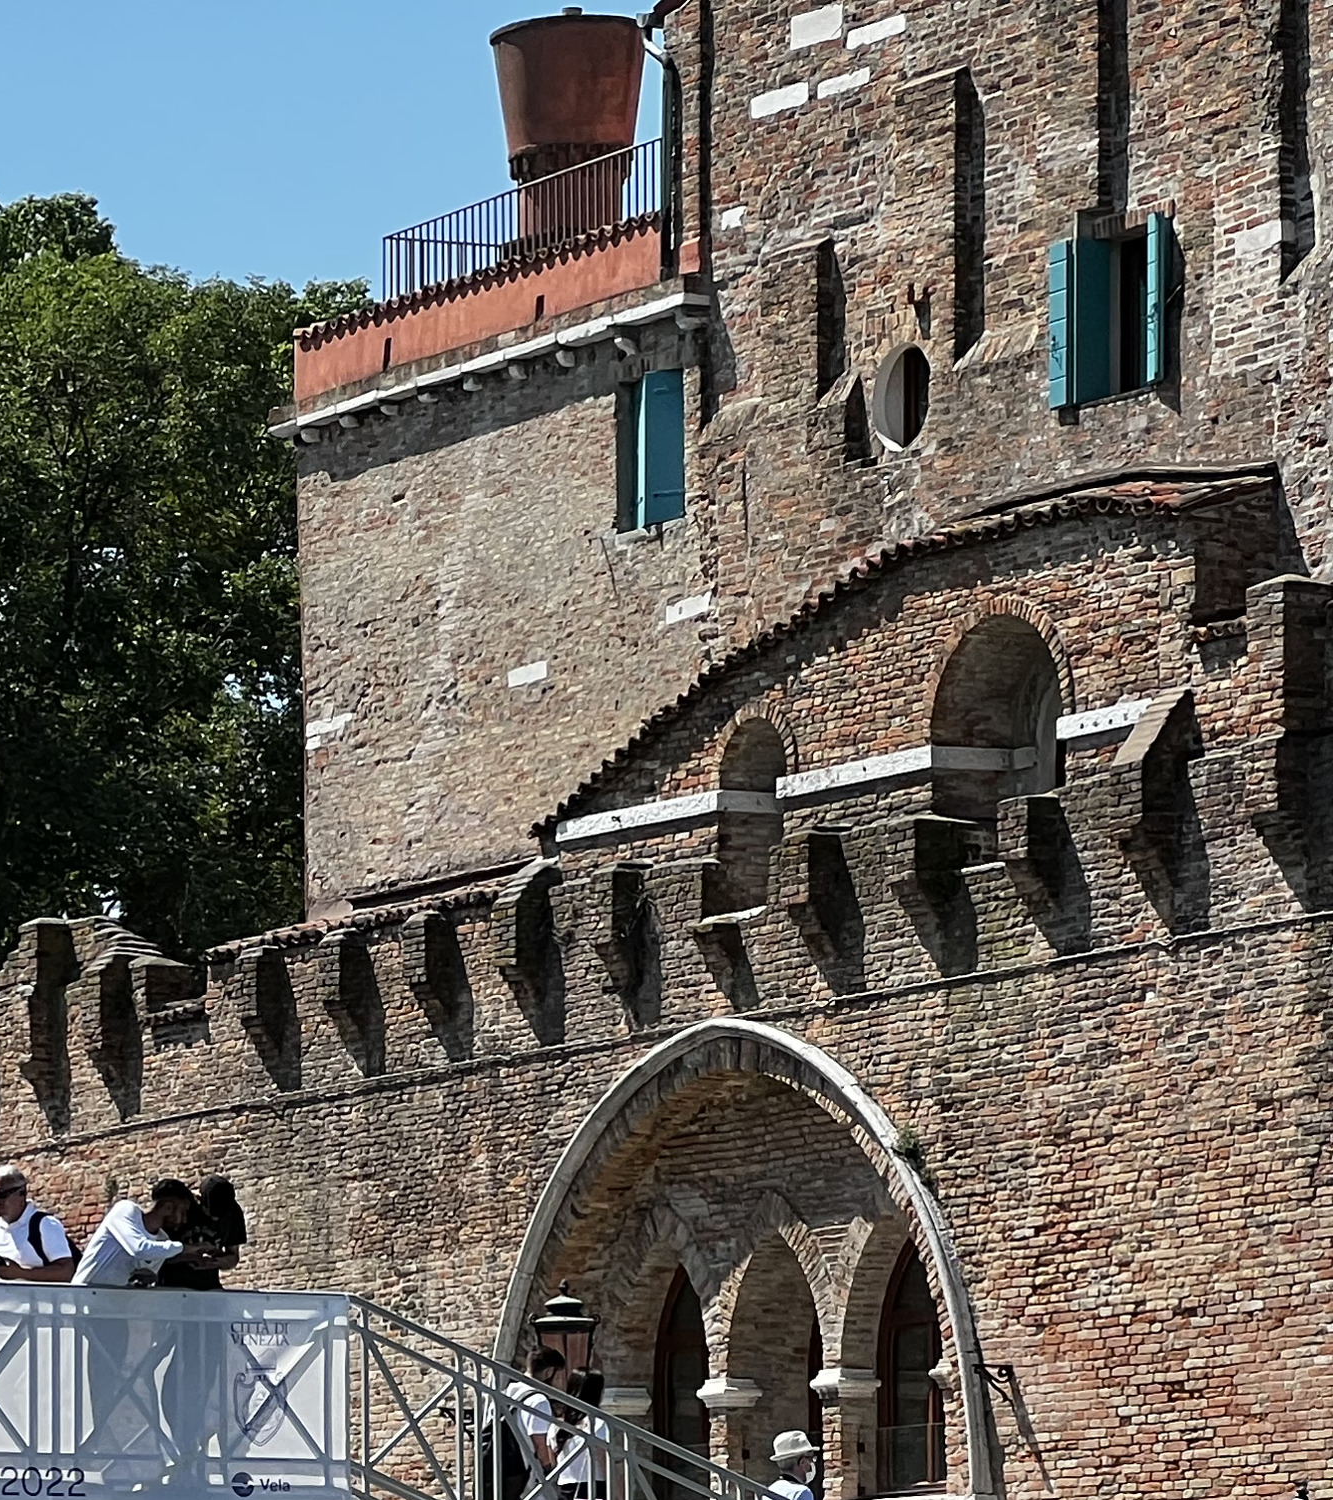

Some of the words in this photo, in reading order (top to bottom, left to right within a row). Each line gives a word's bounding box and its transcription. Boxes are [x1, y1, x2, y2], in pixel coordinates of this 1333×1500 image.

[274, 1321, 290, 1336] DI
[230, 1333, 290, 1347] VENEZIA
[0, 1465, 87, 1498] 2022
[259, 1478, 291, 1492] Vela
